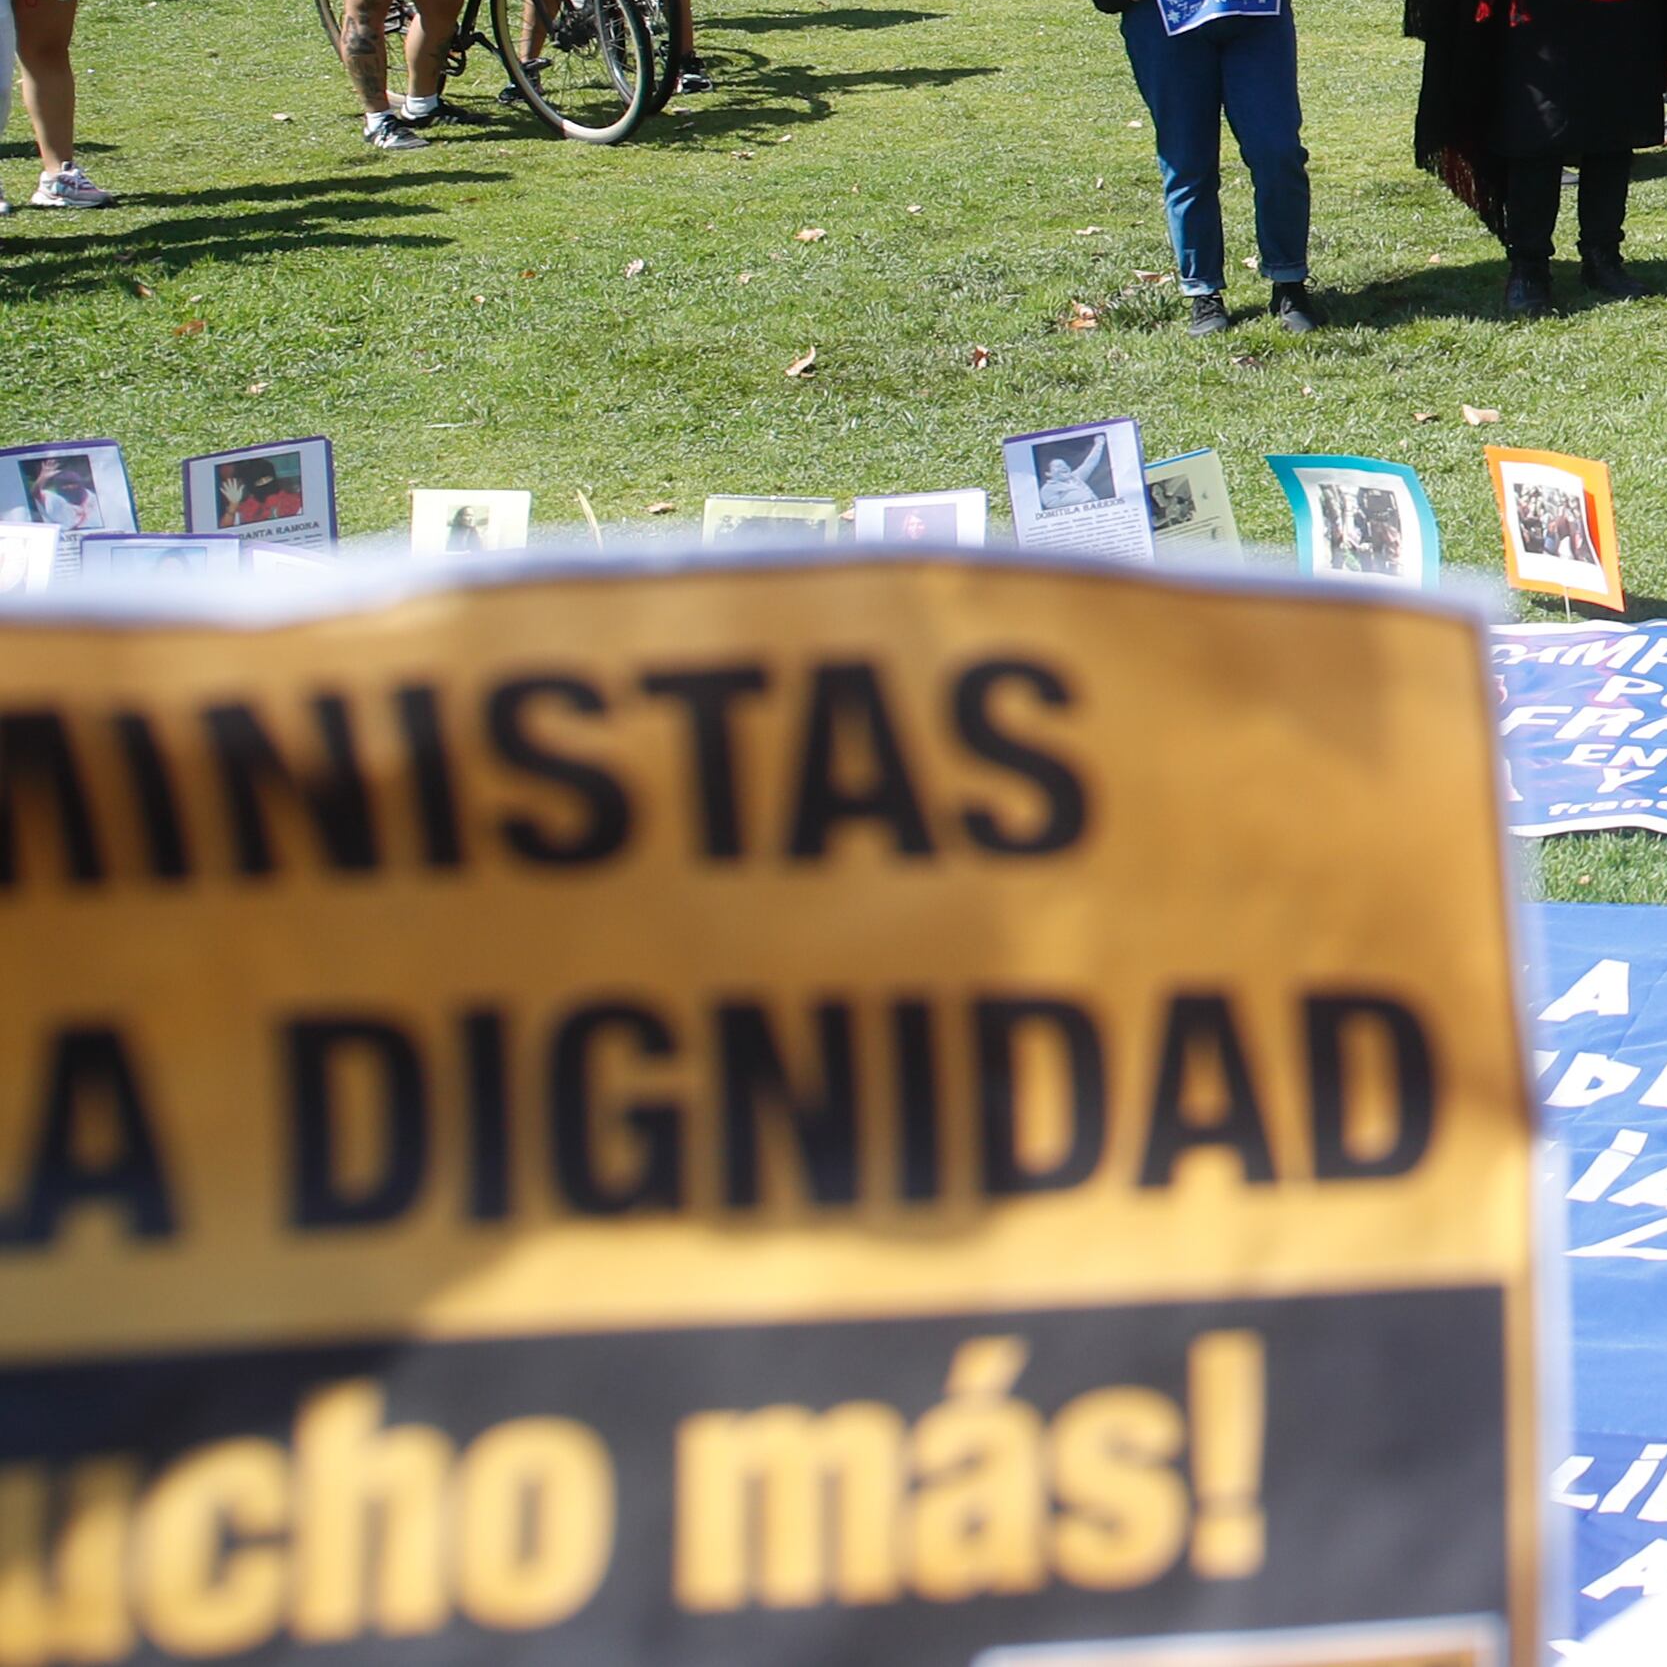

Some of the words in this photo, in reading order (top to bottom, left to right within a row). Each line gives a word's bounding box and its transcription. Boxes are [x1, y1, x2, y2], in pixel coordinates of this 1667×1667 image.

[1598, 767, 1657, 793] Y
[275, 978, 1444, 1243] DIGNIDAD
[672, 1330, 1268, 1615] más!
